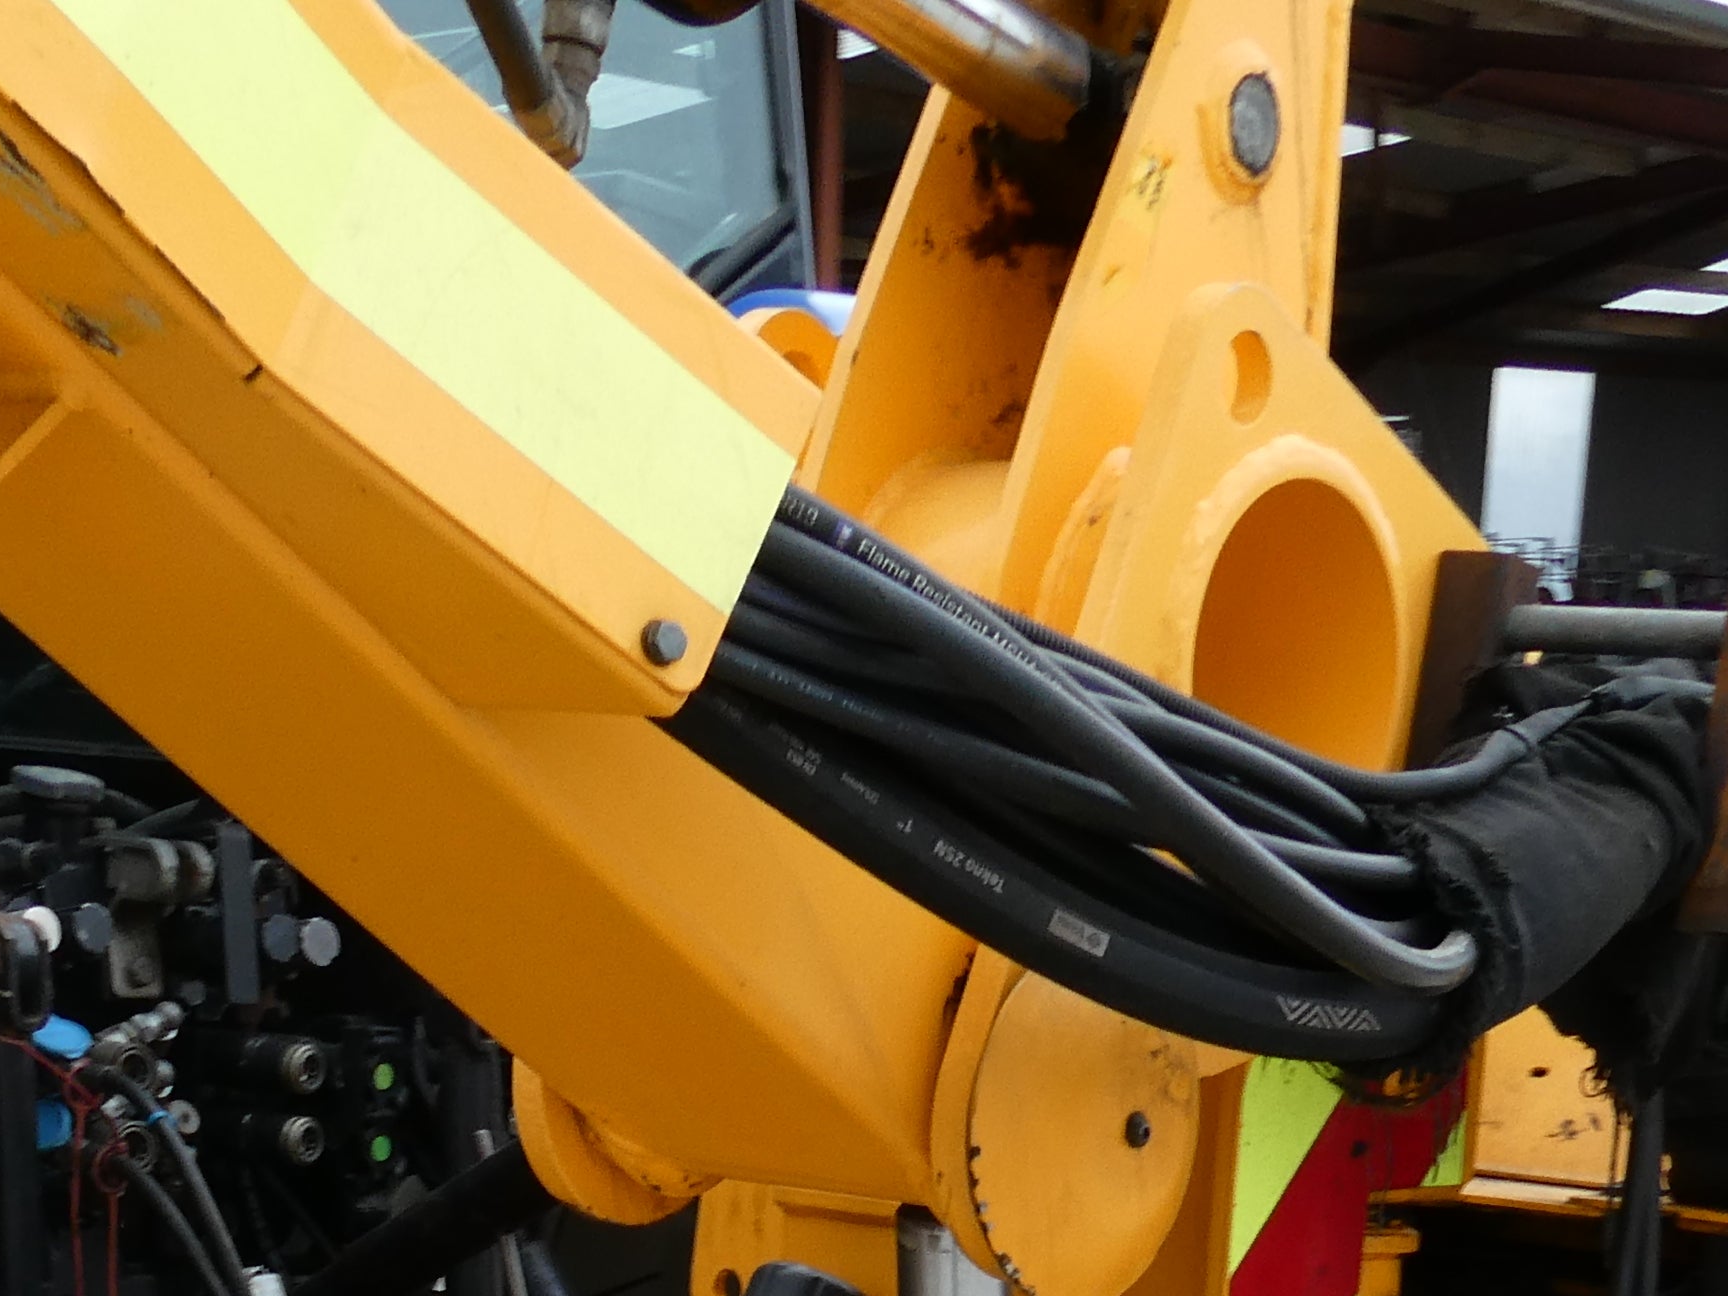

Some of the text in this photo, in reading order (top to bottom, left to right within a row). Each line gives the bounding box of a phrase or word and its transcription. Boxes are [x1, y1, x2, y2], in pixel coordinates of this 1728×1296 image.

[857, 537, 910, 584] Flame
[913, 573, 989, 636] Resistant
[932, 838, 966, 868] 2SN
[964, 857, 1005, 894] Tekno
